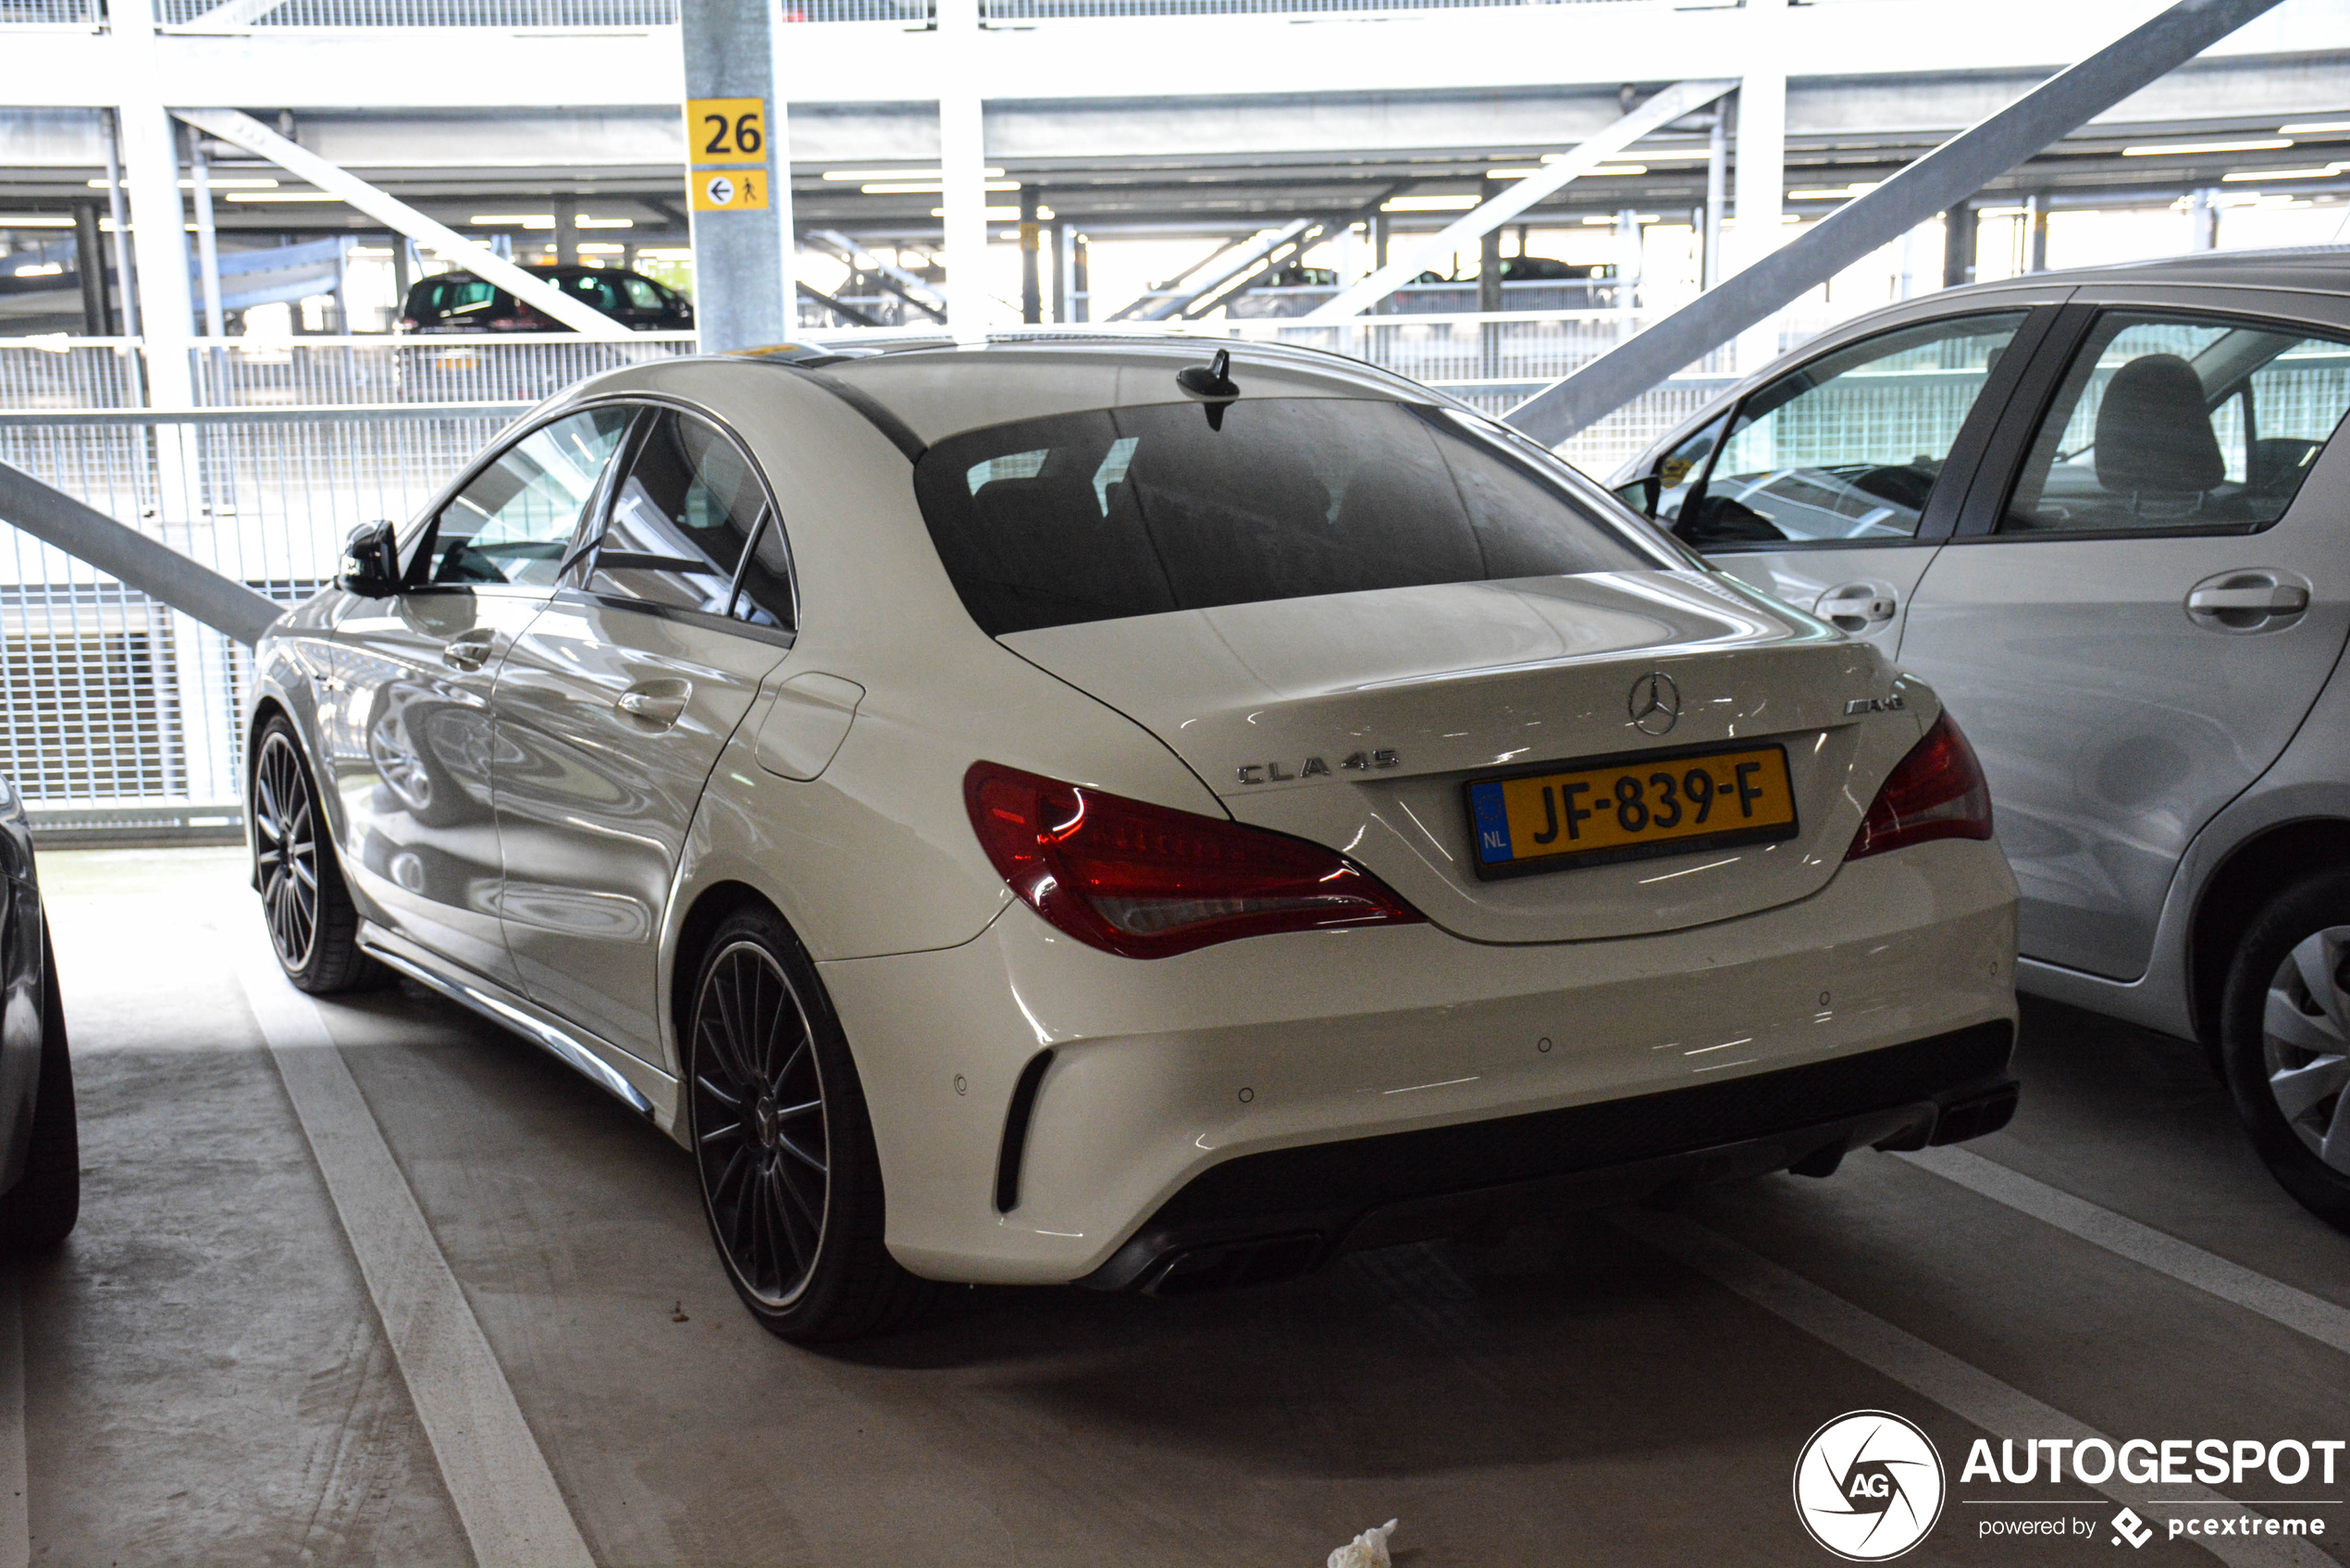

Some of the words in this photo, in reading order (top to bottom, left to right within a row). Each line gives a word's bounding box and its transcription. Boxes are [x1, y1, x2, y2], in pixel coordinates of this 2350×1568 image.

[705, 114, 761, 154] 26
[1237, 757, 1330, 784] CLA
[1342, 750, 1399, 771] 45
[1534, 761, 1763, 844] JF-839-F
[1483, 832, 1506, 848] NL
